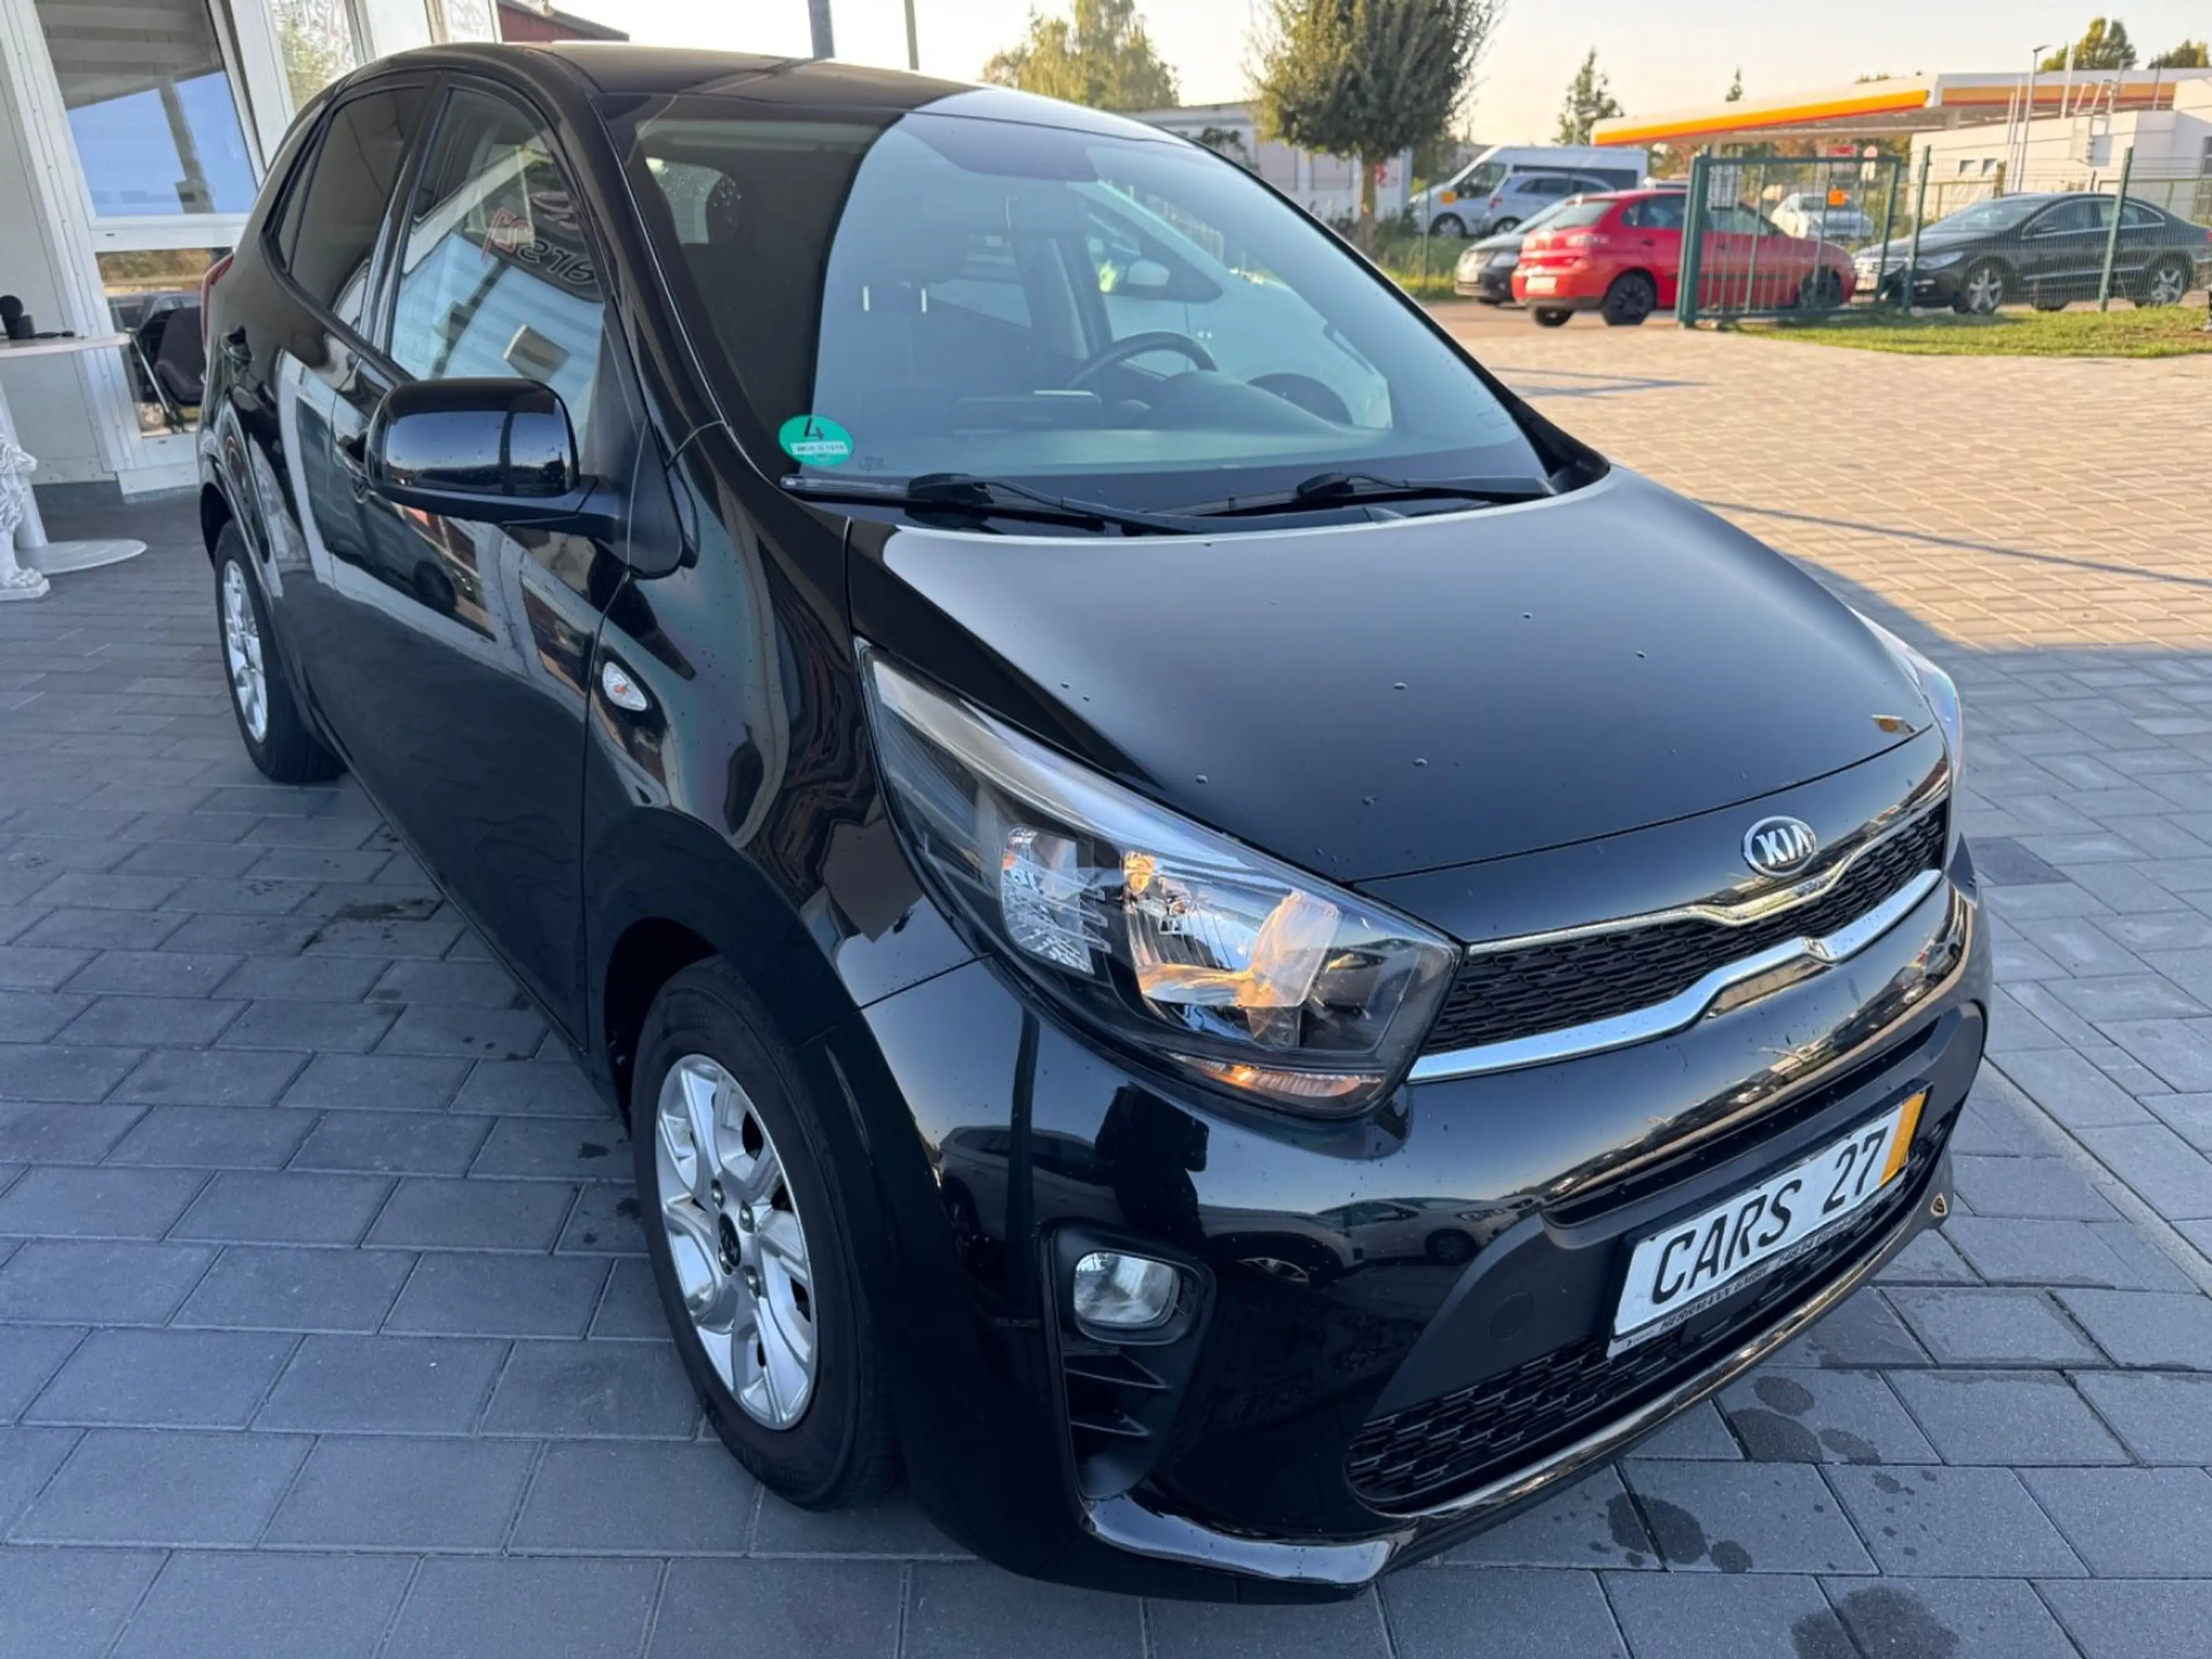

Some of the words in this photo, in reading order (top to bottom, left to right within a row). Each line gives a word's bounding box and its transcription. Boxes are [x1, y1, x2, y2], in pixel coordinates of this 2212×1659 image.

[804, 417, 825, 441] 4
[1755, 825, 1813, 866] KIA
[1652, 1179, 1802, 1305] CARS
[1822, 1127, 1888, 1215] 27
